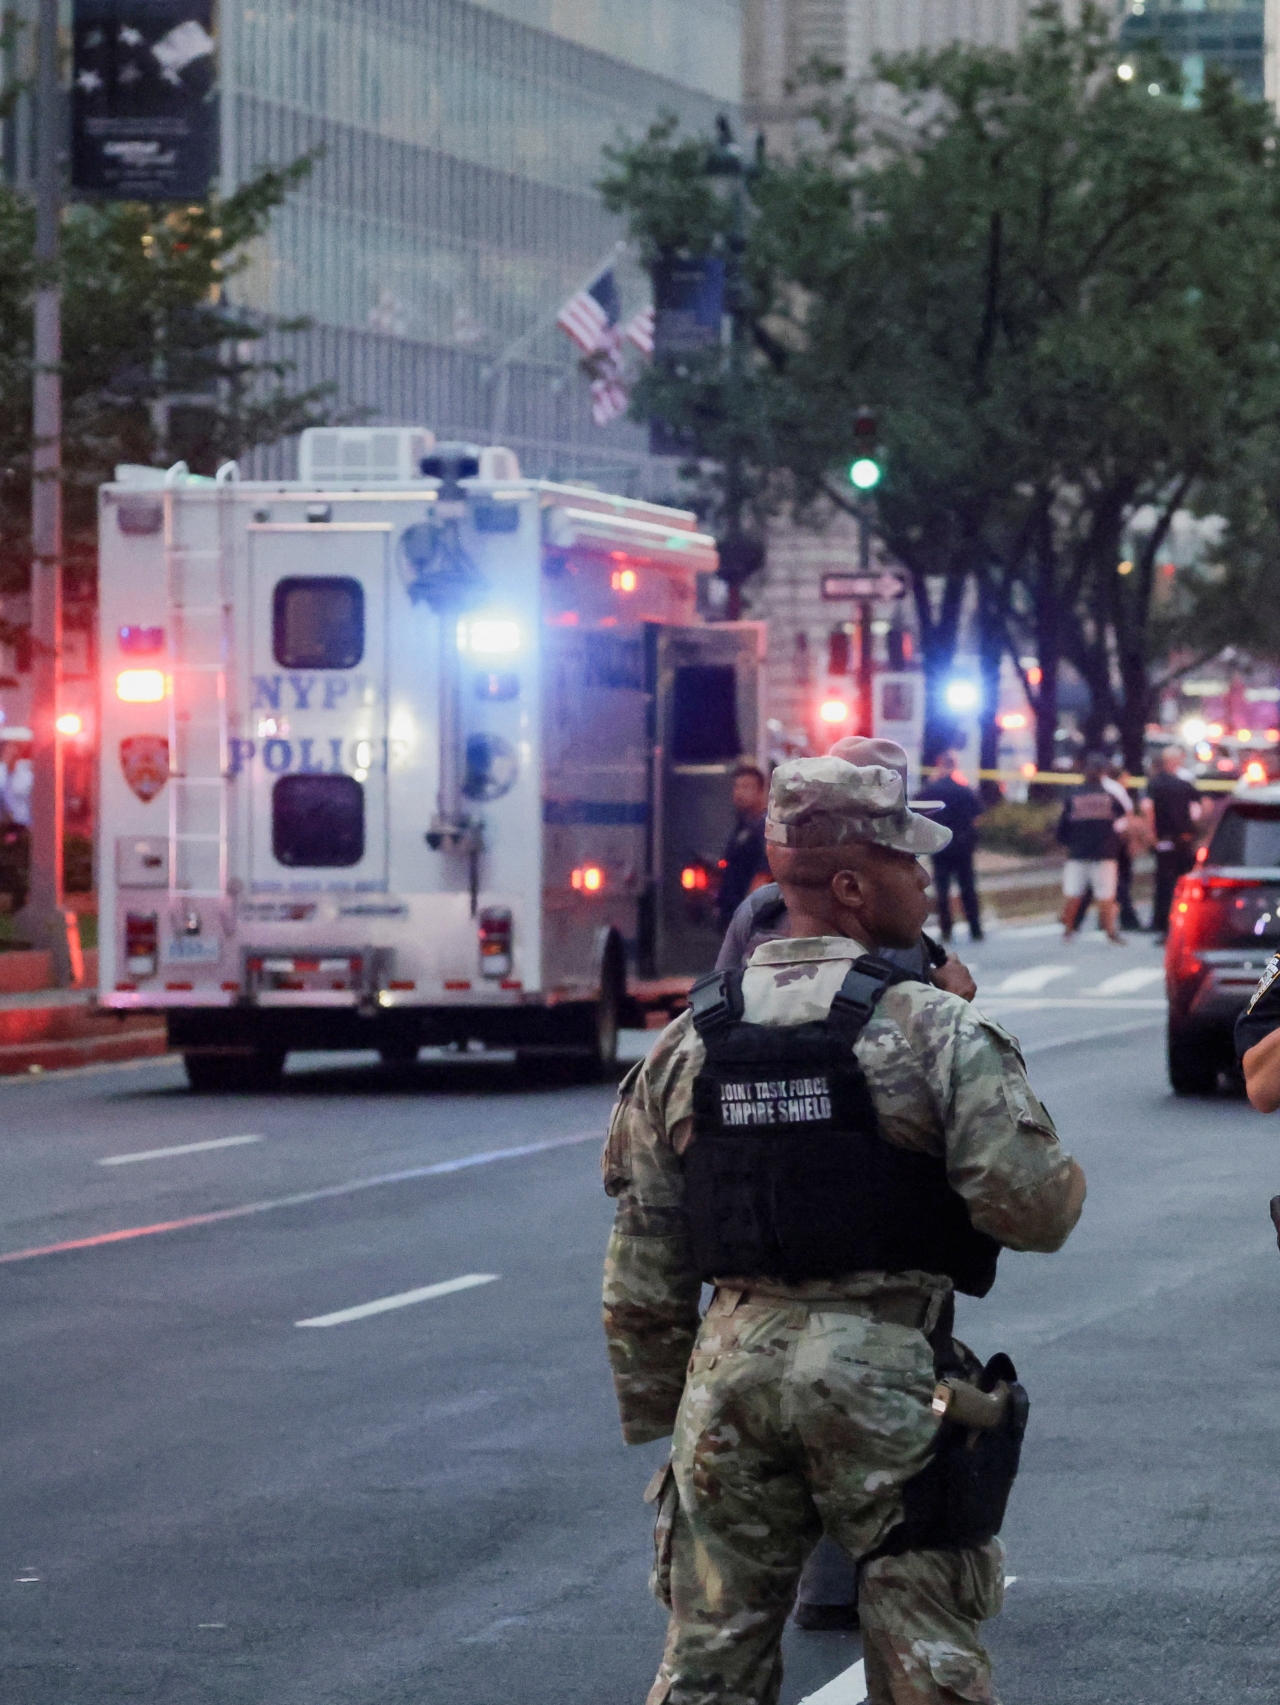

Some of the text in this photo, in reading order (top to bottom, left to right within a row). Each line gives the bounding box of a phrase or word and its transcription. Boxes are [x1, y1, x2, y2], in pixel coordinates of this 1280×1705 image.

[720, 1077, 830, 1101] JOINT TASK FORCE
[721, 1096, 833, 1126] EMPIRE SHIELD
